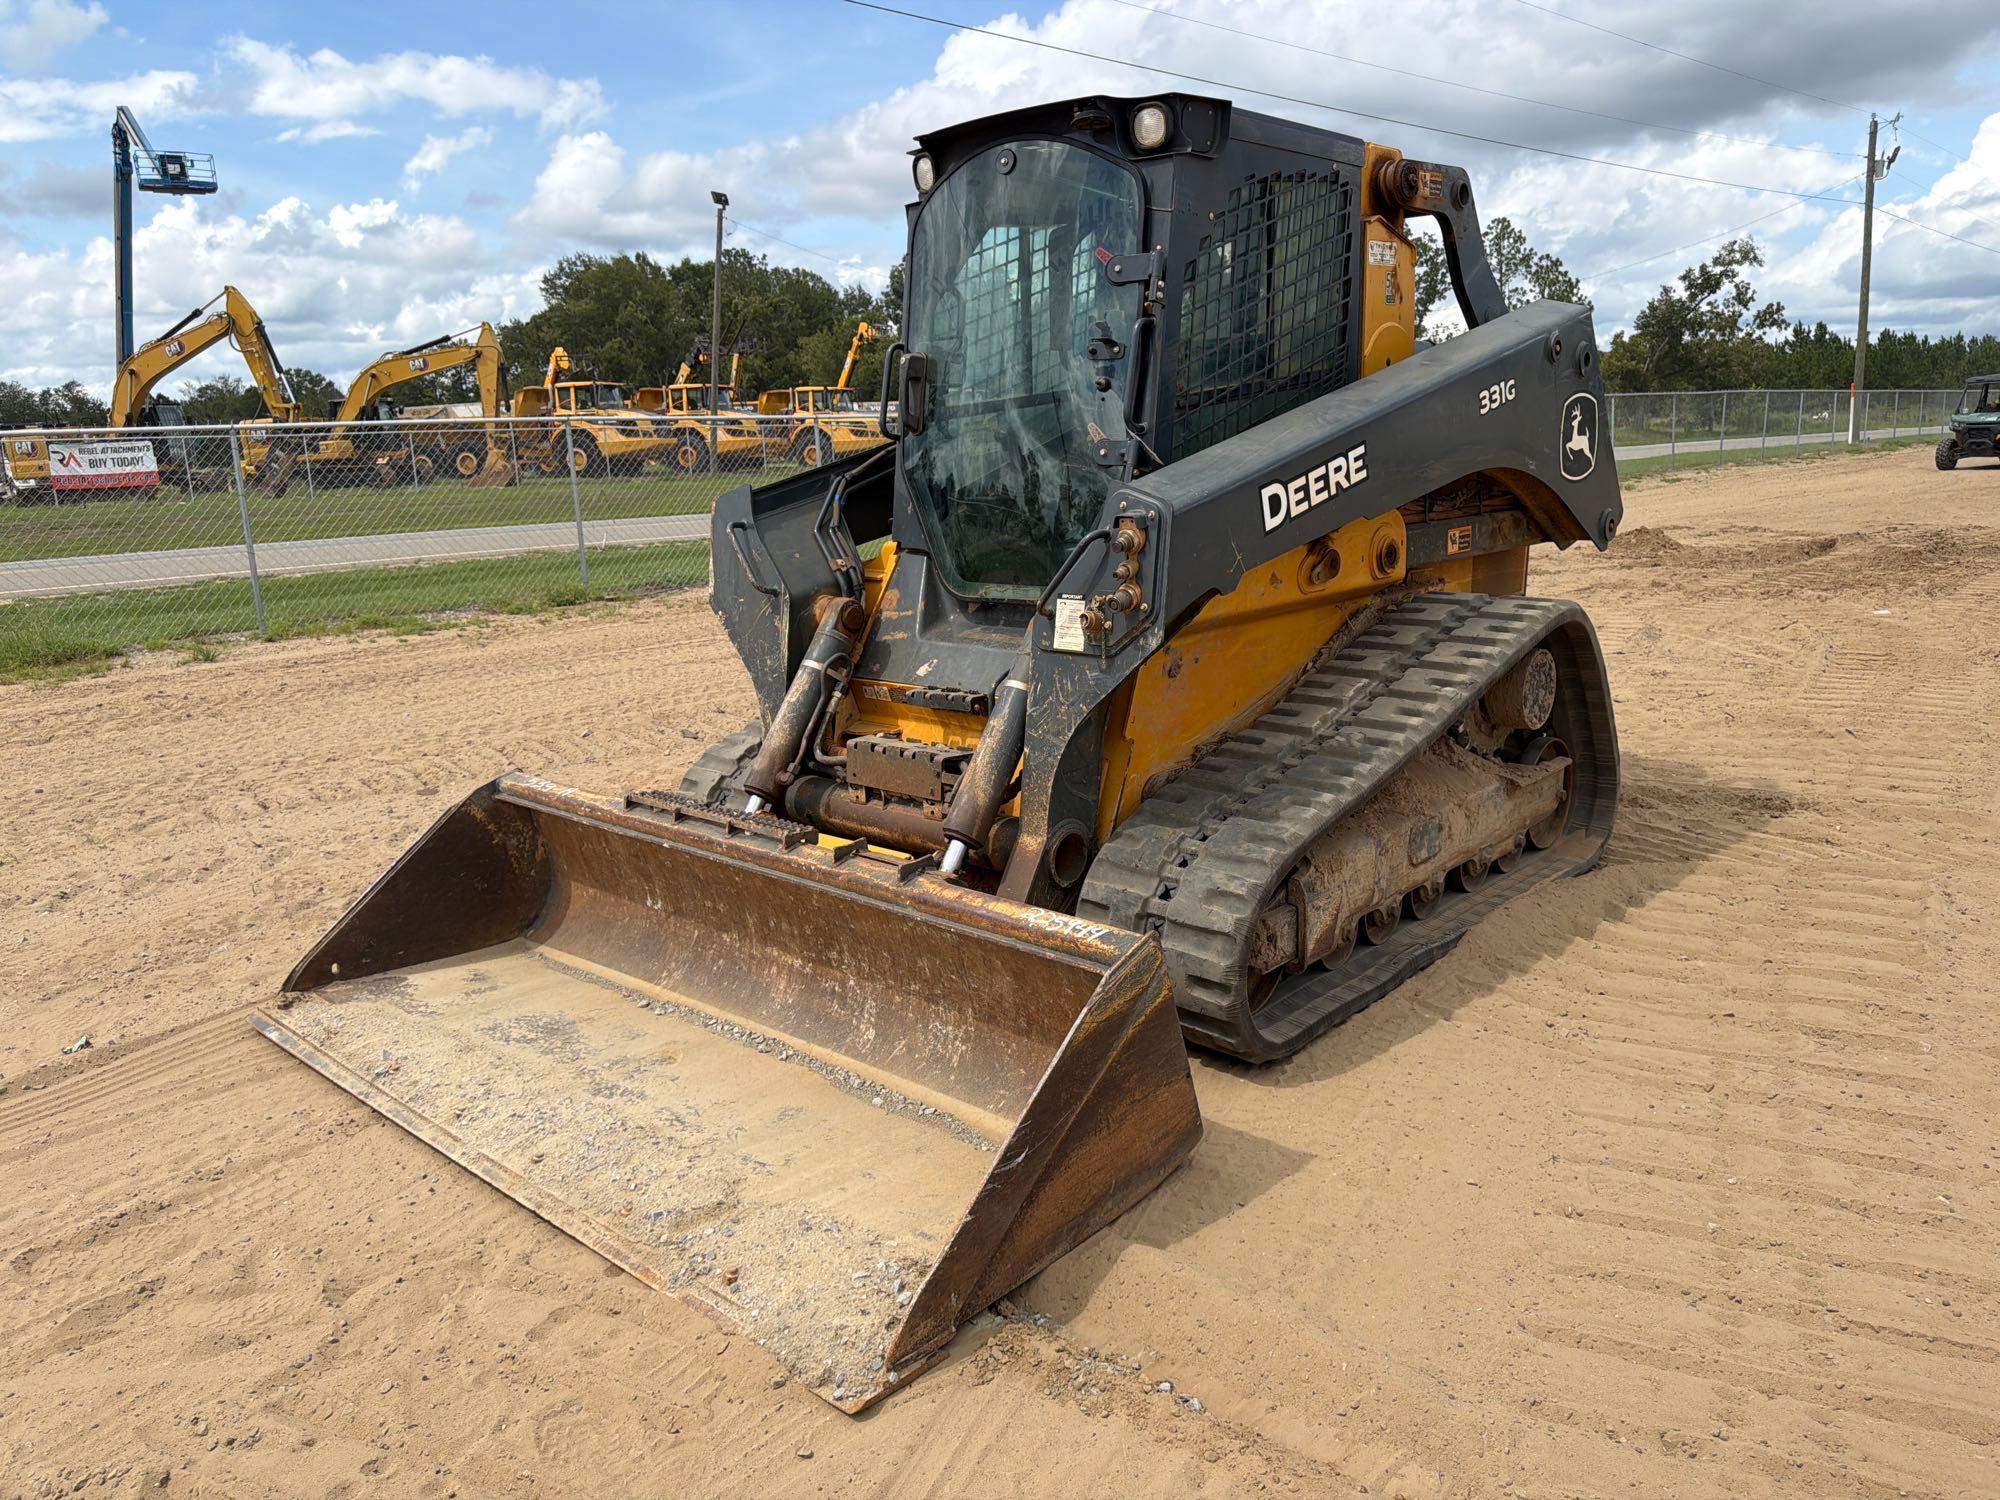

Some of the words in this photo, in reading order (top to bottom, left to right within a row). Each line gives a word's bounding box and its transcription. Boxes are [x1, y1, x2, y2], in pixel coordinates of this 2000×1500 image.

[165, 341, 182, 358] CAT
[409, 358, 425, 371] CAT
[1479, 379, 1516, 415] 331G
[15, 441, 33, 455] CAT
[78, 446, 99, 456] REBEL
[100, 444, 151, 455] ATTACHMENTS
[88, 458, 107, 469] BUY
[111, 456, 144, 468] TODAY!
[1260, 444, 1368, 532] DEERE
